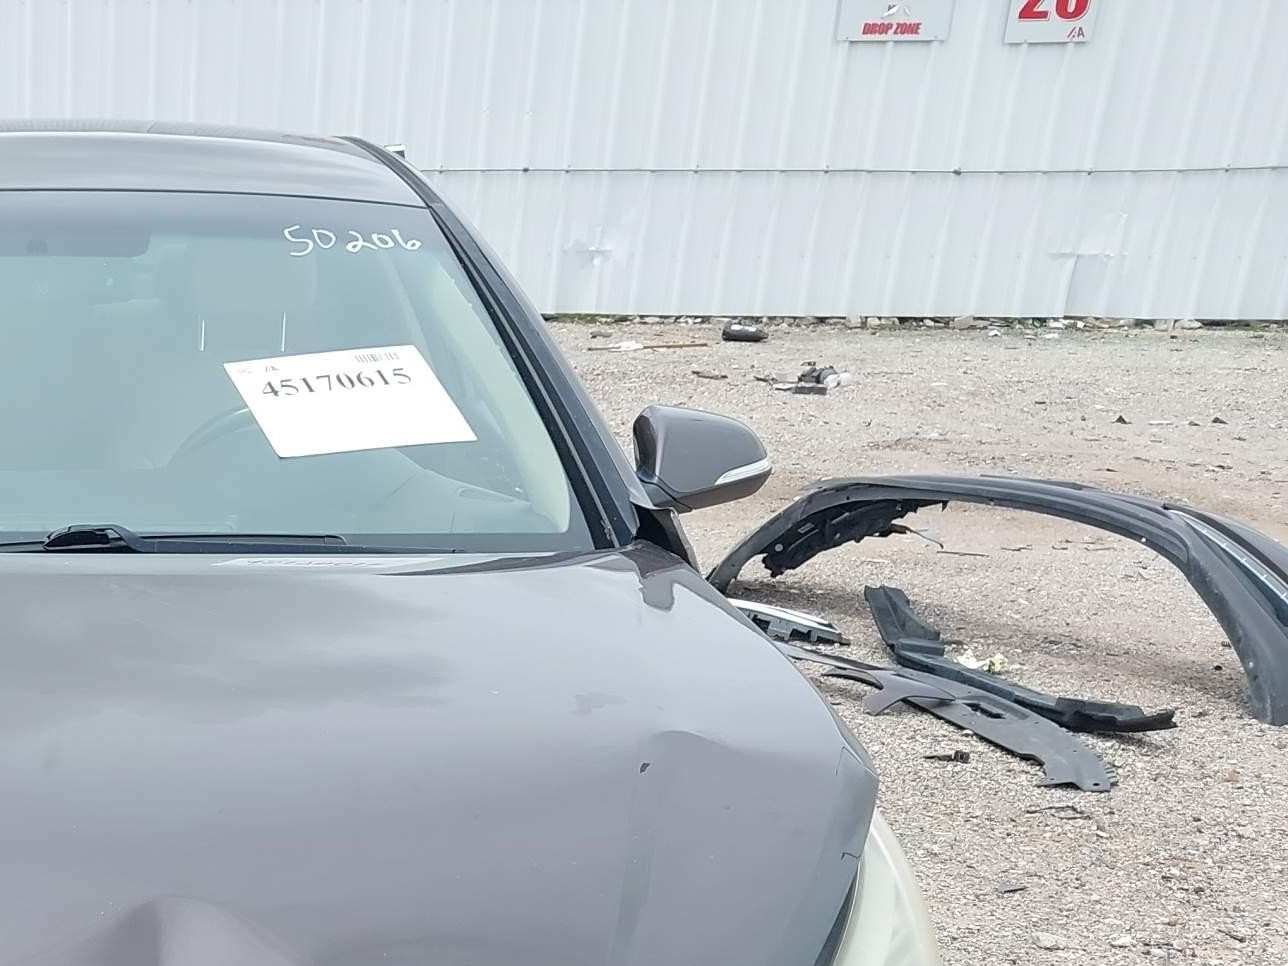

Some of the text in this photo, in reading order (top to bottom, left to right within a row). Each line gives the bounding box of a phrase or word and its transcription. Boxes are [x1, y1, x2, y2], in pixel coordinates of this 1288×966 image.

[862, 22, 922, 35] DROP ZONE
[262, 368, 412, 397] 45170615
